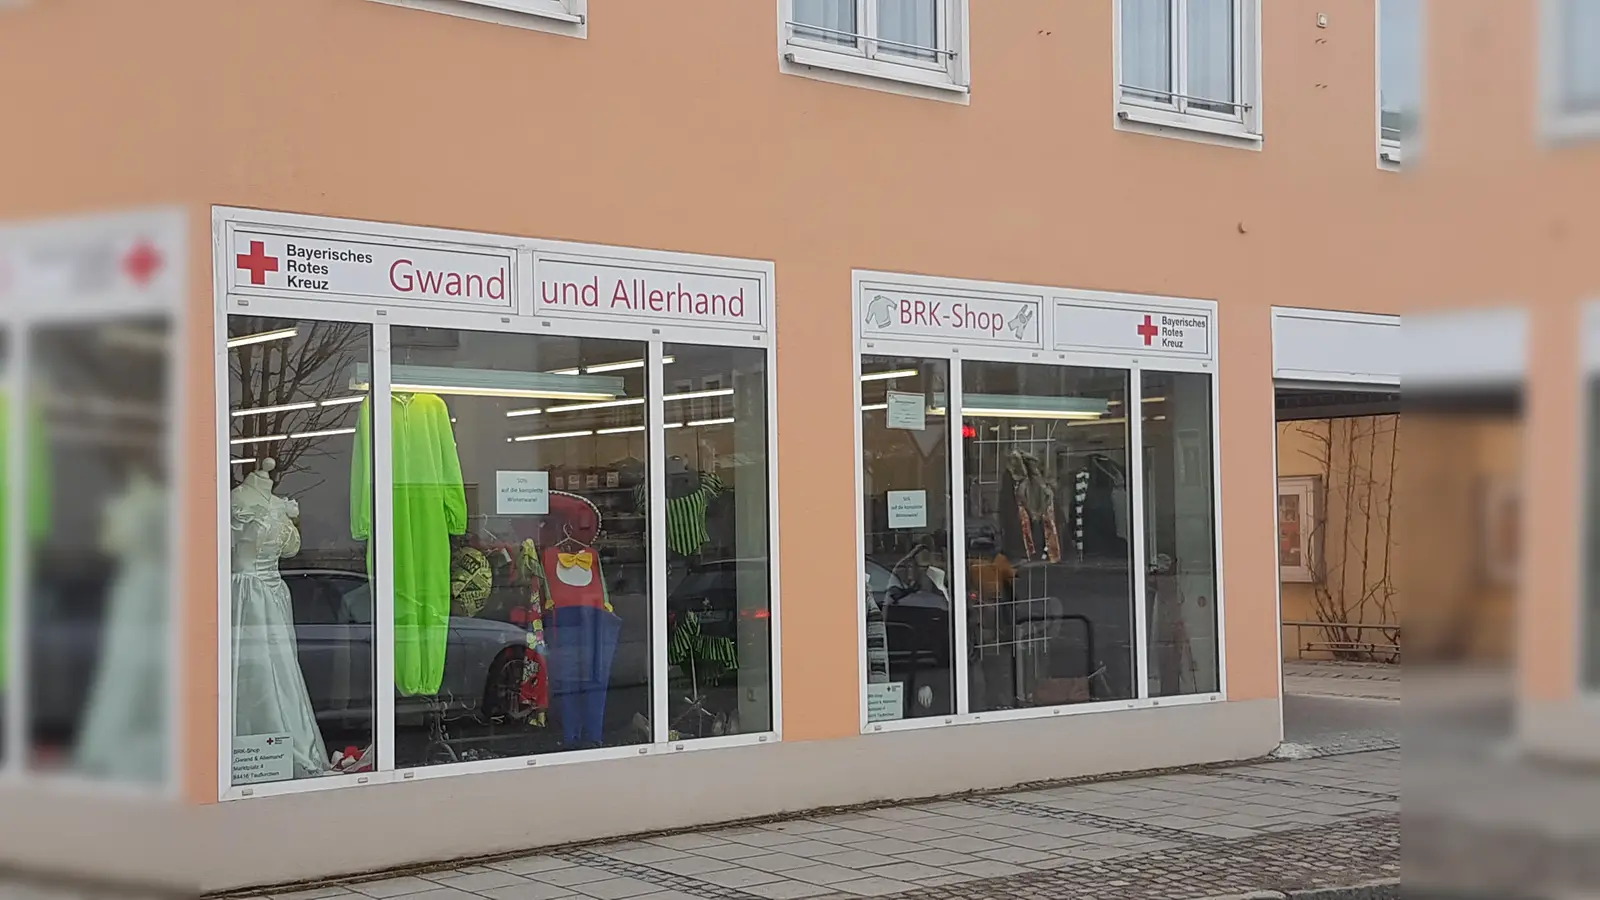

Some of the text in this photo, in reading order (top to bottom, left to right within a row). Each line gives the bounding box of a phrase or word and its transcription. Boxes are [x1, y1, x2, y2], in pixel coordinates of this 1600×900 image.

[286, 244, 373, 264] Bayerisches
[287, 260, 329, 275] Rotes
[287, 275, 329, 290] Kreuz
[389, 258, 744, 317] Gwand und Allerhand
[900, 299, 1004, 338] BRK-Shop
[1162, 316, 1206, 328] Bayerisches
[1162, 327, 1183, 337] Rotes
[1162, 338, 1183, 348] Kreuz
